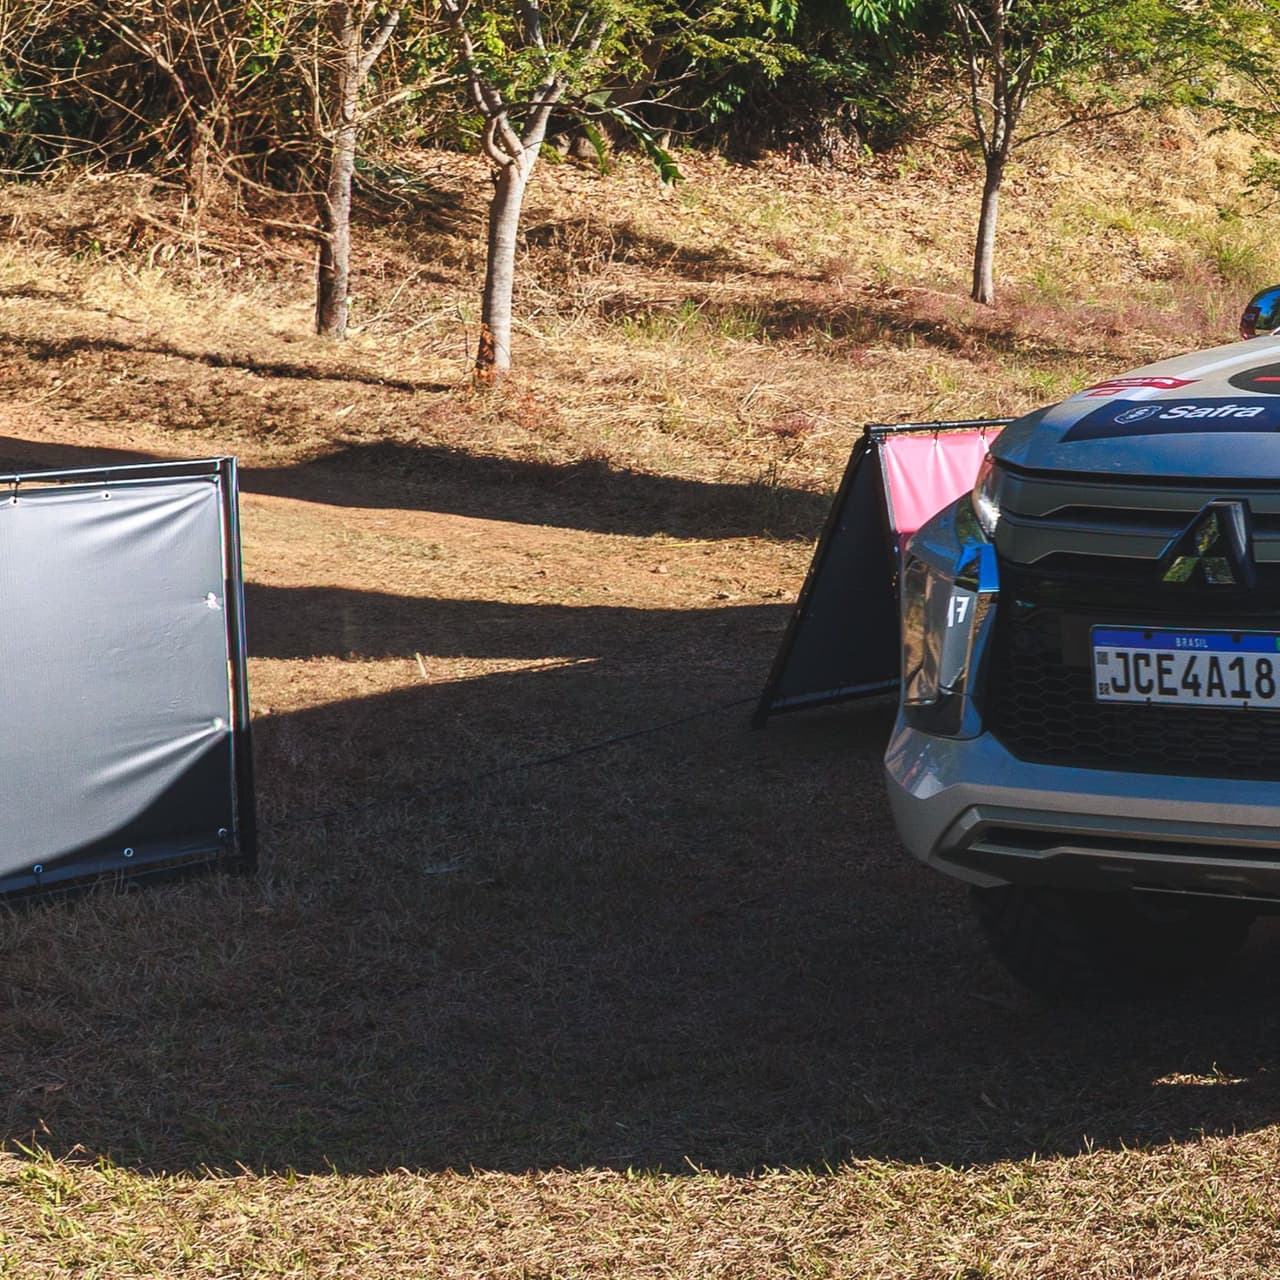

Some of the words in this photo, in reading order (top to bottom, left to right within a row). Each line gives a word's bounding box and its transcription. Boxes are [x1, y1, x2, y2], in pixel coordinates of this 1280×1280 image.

[1159, 405, 1265, 420] Safra
[1175, 636, 1209, 648] BRASIL
[1111, 651, 1276, 699] JCE4A18
